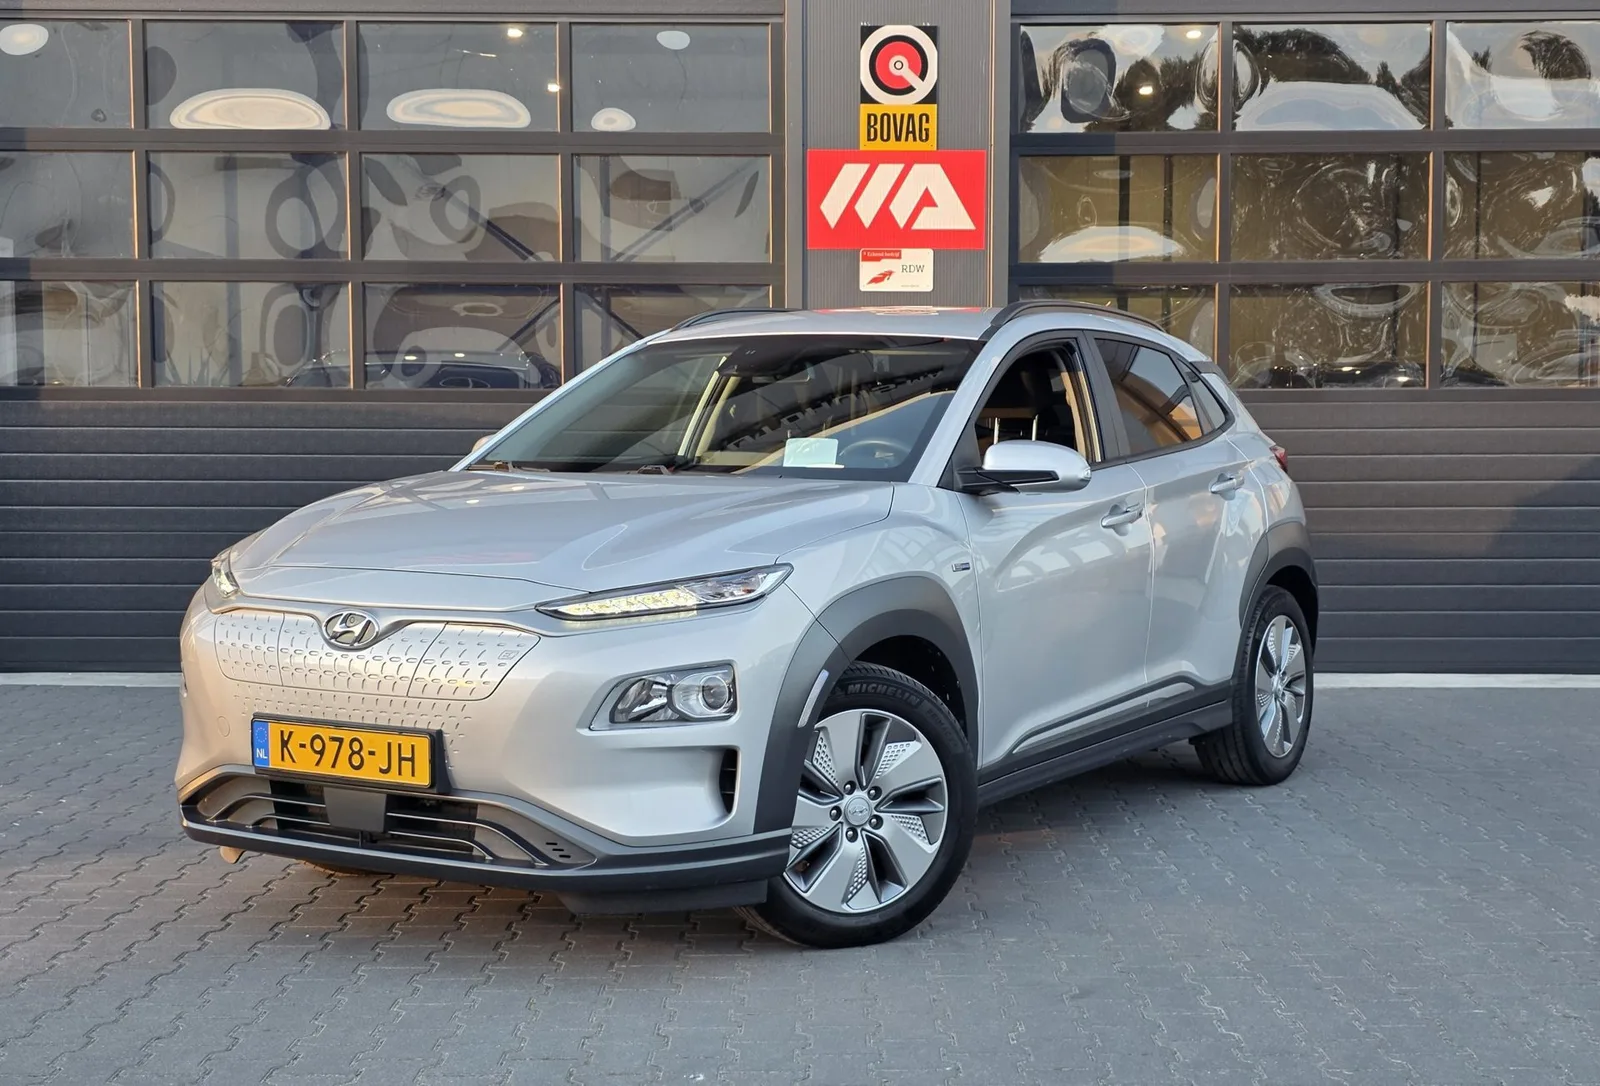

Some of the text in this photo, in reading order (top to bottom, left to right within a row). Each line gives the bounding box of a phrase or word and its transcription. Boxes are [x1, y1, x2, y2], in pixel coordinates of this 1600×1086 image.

[867, 113, 930, 143] BOVAG
[901, 264, 925, 273] RDW
[847, 683, 921, 706] MICHELIN
[256, 748, 268, 759] NL
[280, 729, 416, 777] K-978-JH
